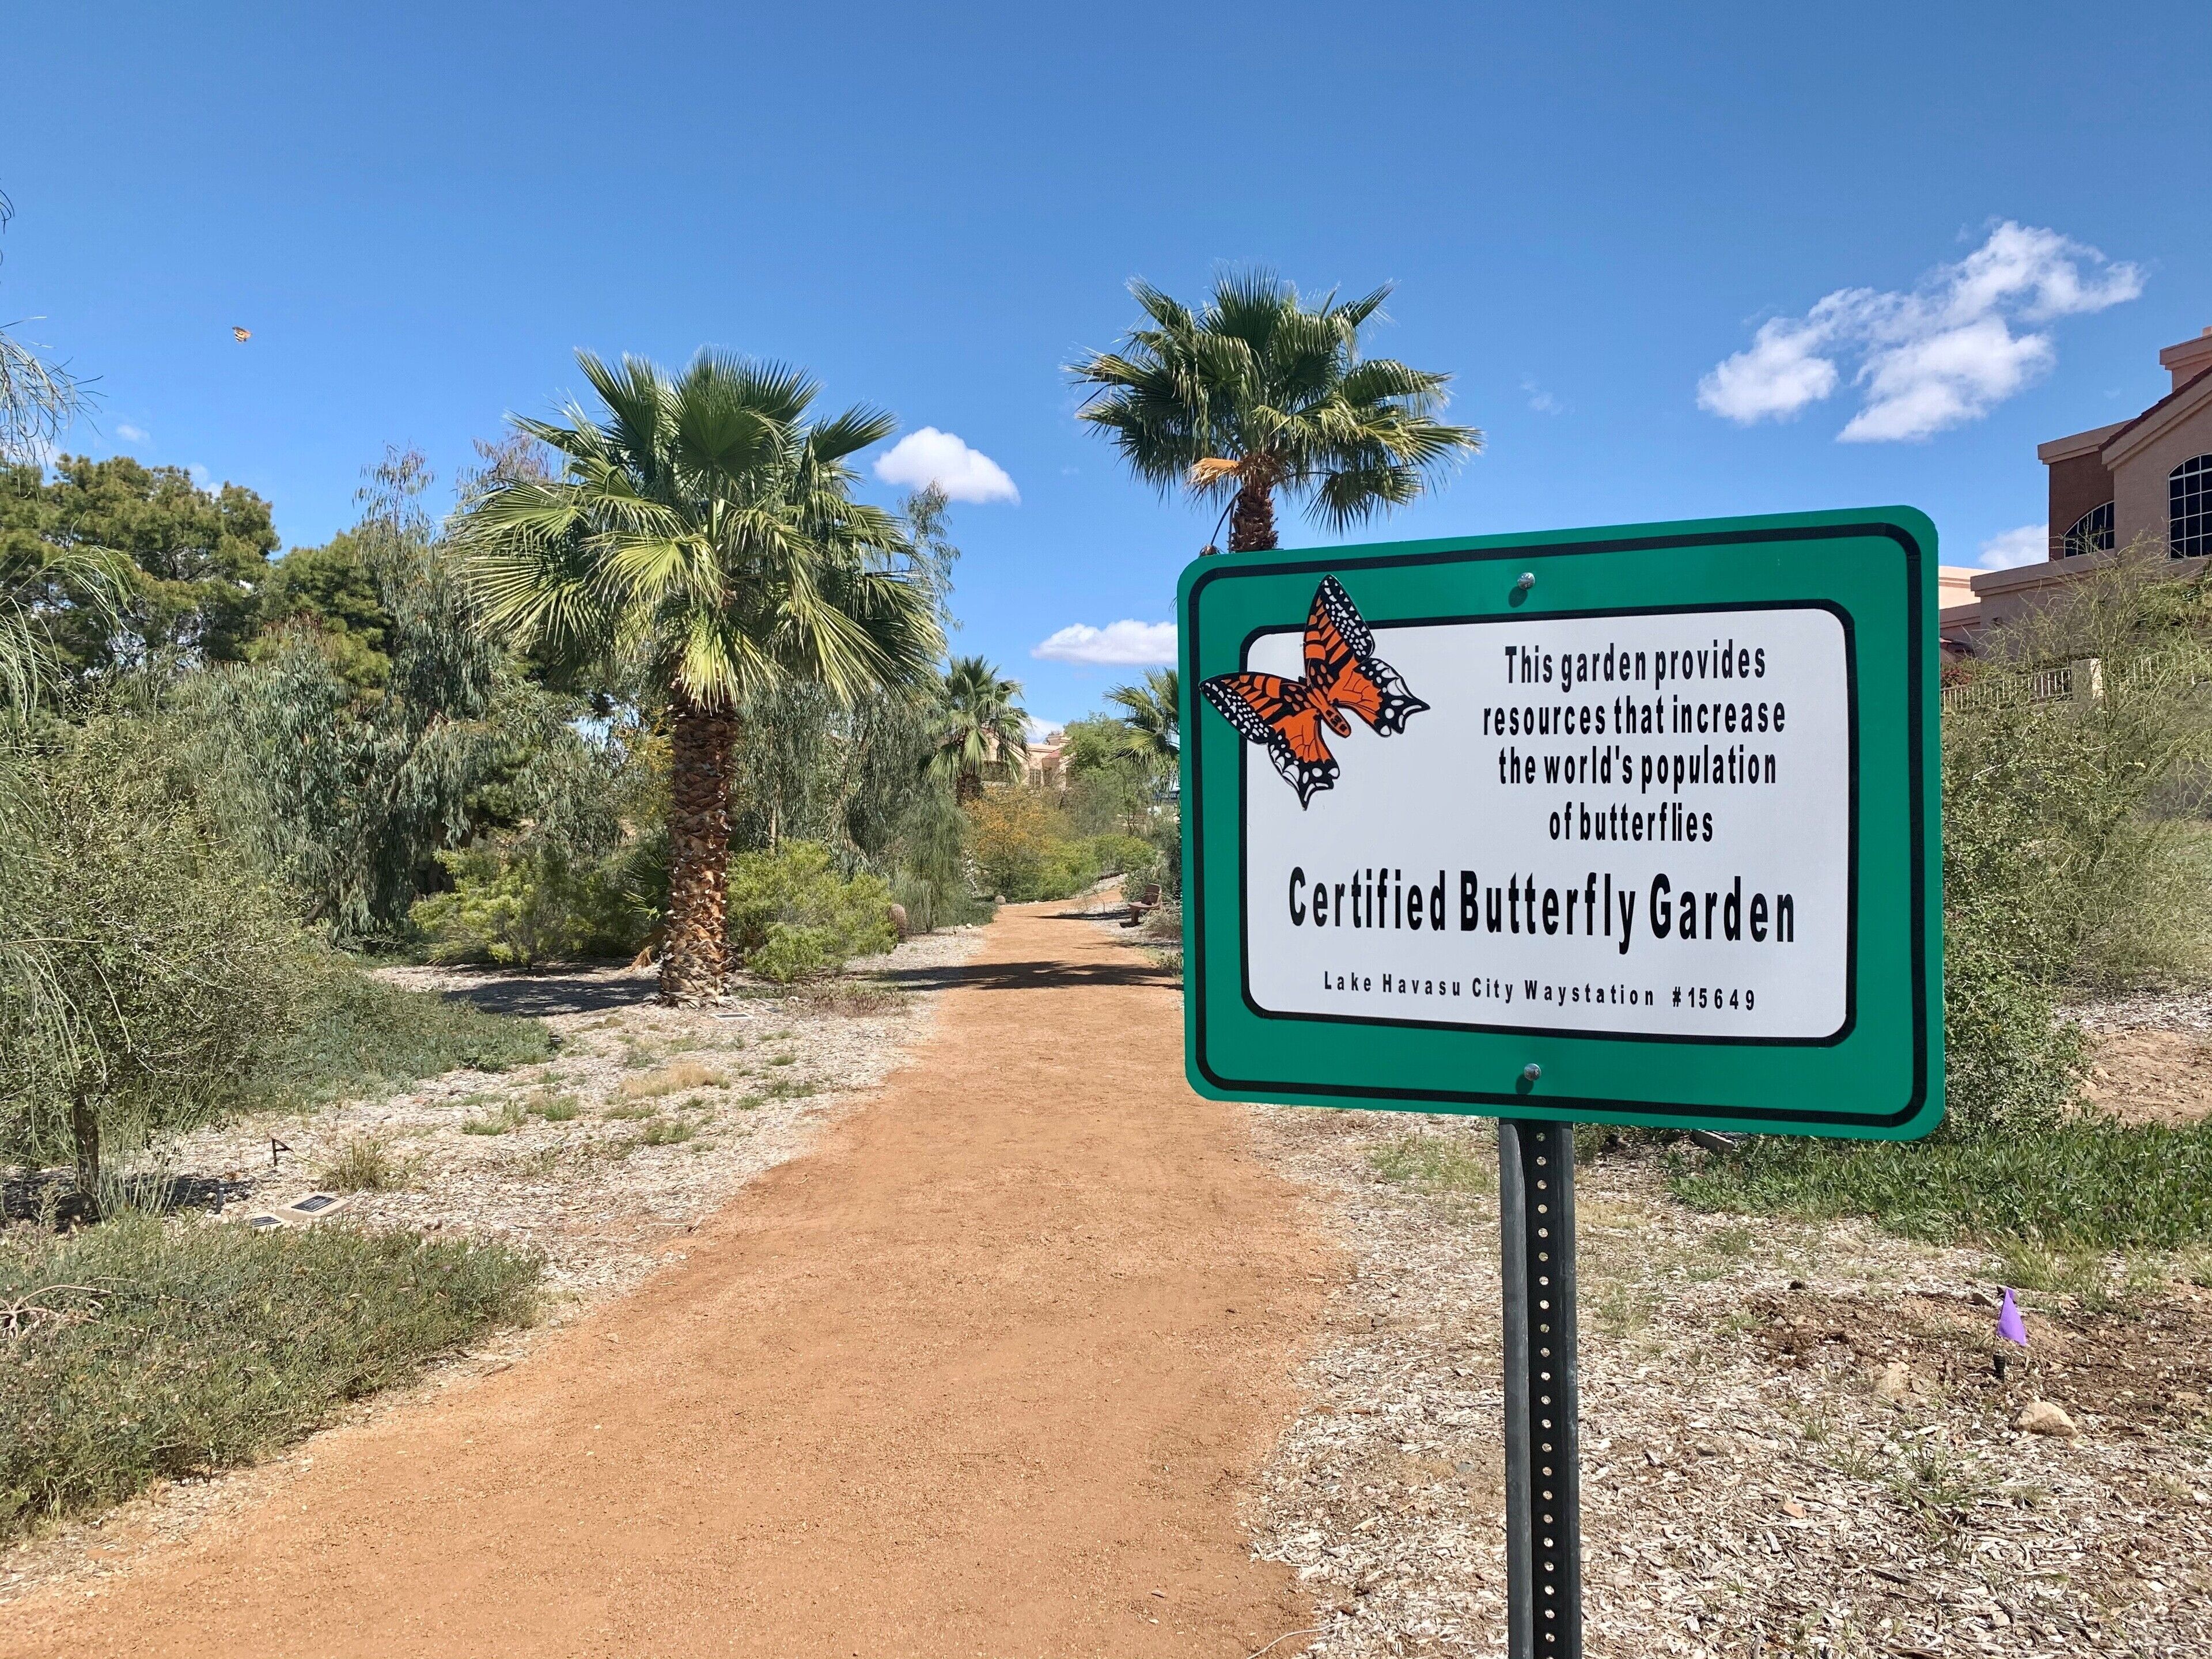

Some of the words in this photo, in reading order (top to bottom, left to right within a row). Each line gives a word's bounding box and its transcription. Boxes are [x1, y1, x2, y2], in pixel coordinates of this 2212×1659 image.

[1505, 645, 1552, 684] This
[1561, 642, 1646, 693] garden
[1655, 639, 1765, 691] provides
[1483, 705, 1605, 736] resources
[1614, 695, 1664, 735] that
[1673, 694, 1785, 734] increase
[1499, 747, 1536, 785] the
[1544, 745, 1633, 785] world's
[1641, 744, 1776, 794] population
[1549, 801, 1572, 840] of
[1580, 801, 1713, 842] butterflies
[1289, 866, 1445, 931] Certified
[1460, 872, 1636, 955] Butterfly
[1650, 873, 1794, 942] Garden
[1324, 971, 1371, 992] Lake
[1382, 974, 1460, 996] Havasu
[1472, 977, 1513, 1004] City
[1524, 979, 1653, 1007] Waystation
[1672, 986, 1755, 1011] #15649
